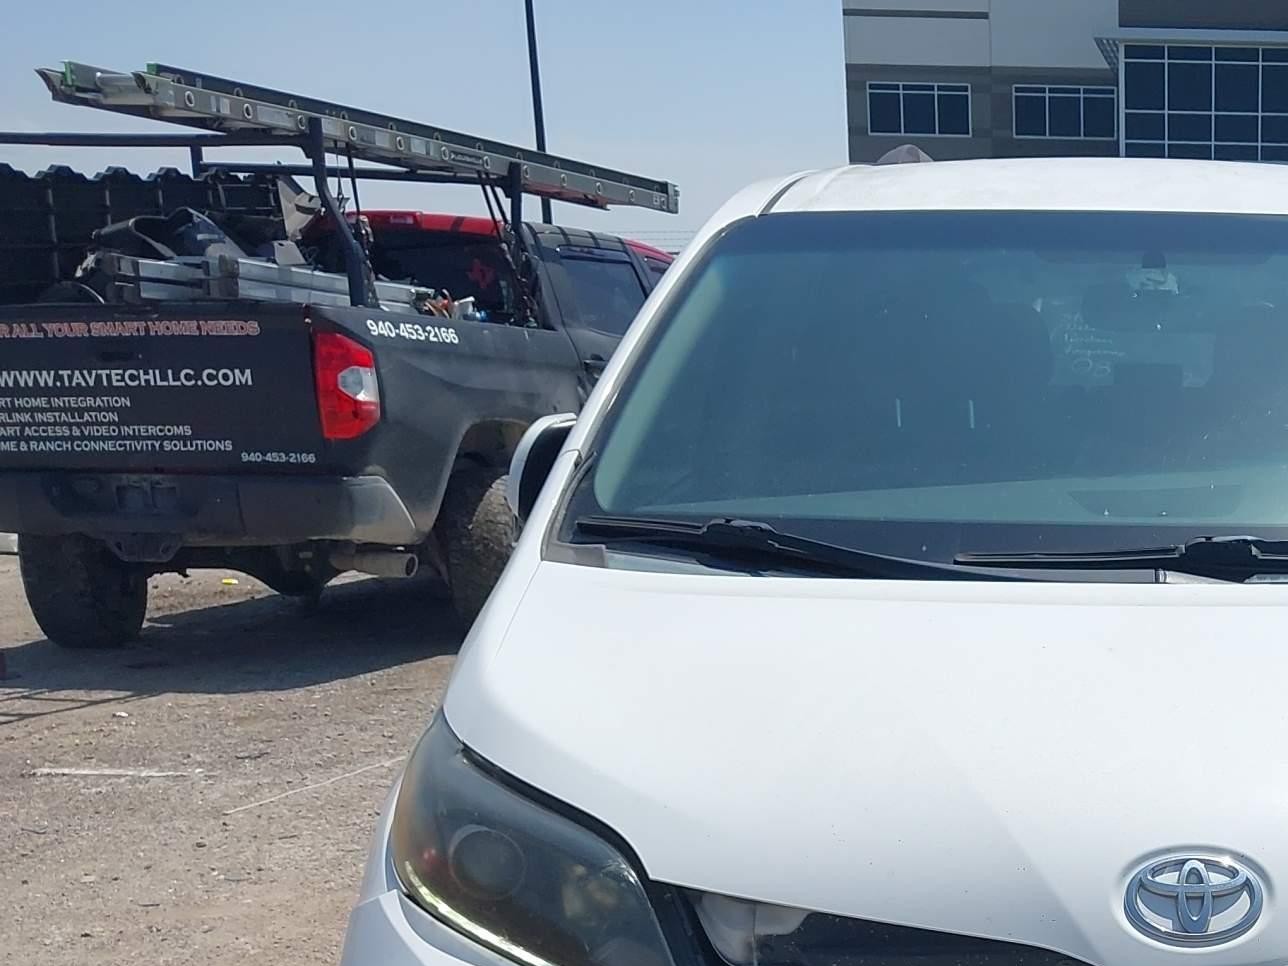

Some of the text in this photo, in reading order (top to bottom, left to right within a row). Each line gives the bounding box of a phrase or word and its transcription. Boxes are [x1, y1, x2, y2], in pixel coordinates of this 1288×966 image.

[12, 323, 44, 338] ALL
[42, 322, 89, 337] YOUR
[90, 321, 146, 336] SMART
[147, 320, 199, 336] HOME
[200, 320, 260, 336] NEEDS
[366, 319, 459, 344] 940-453-2166
[0, 368, 253, 388] WWW.TAVTECHLLC.COM
[14, 397, 50, 408] HOME
[50, 396, 131, 408] INTEGRATION
[34, 411, 119, 423] INSTALLATION
[24, 426, 70, 436] ACCESS
[72, 426, 81, 436] &
[81, 426, 119, 436] VIDEO
[120, 425, 192, 436] INTERCOMS
[19, 441, 28, 451] &
[30, 441, 71, 451] RANCH
[73, 440, 161, 451] CONNECTIVITY
[162, 440, 233, 451] SOLUTIONS
[240, 452, 317, 463] 940-453-2166
